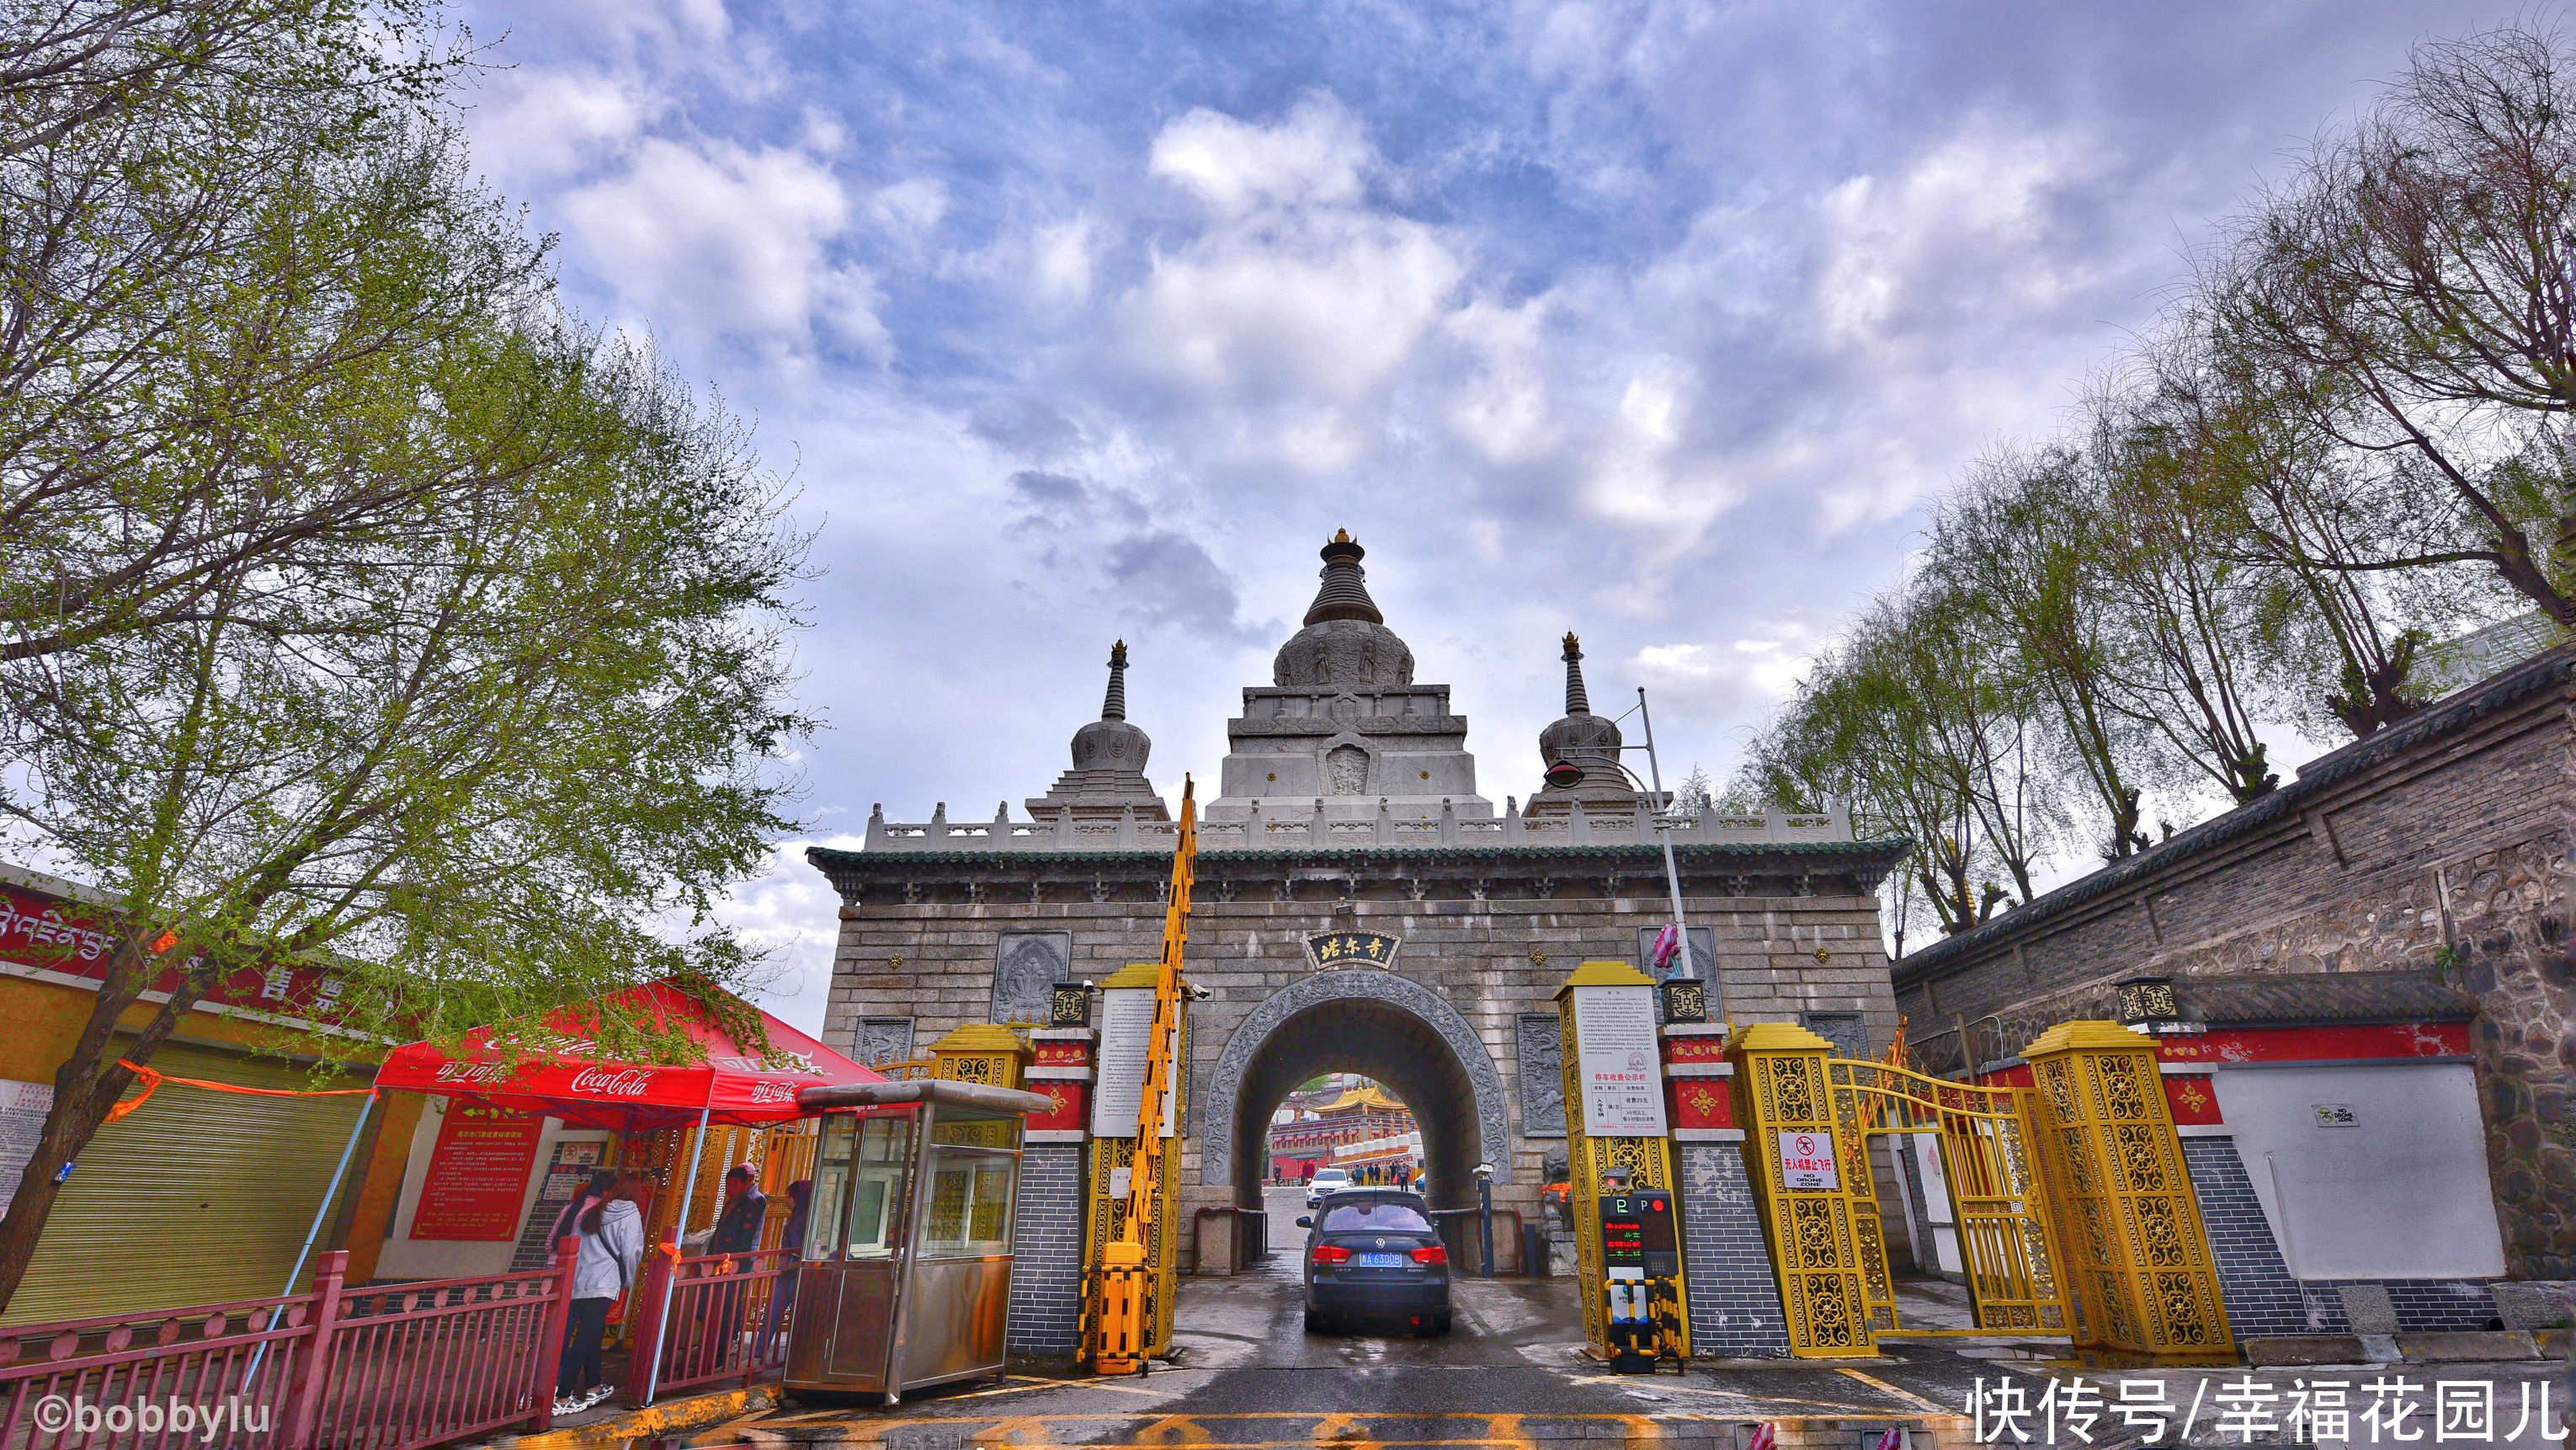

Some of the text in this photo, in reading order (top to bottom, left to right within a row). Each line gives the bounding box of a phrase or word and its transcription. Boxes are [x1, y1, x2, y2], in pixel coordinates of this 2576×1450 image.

[1319, 936, 1383, 961] 塔尔寺
[571, 1066, 657, 1096] Coca-Cola
[1785, 1159, 1831, 1171] 无人机禁止飞行
[1641, 1200, 1647, 1211] P
